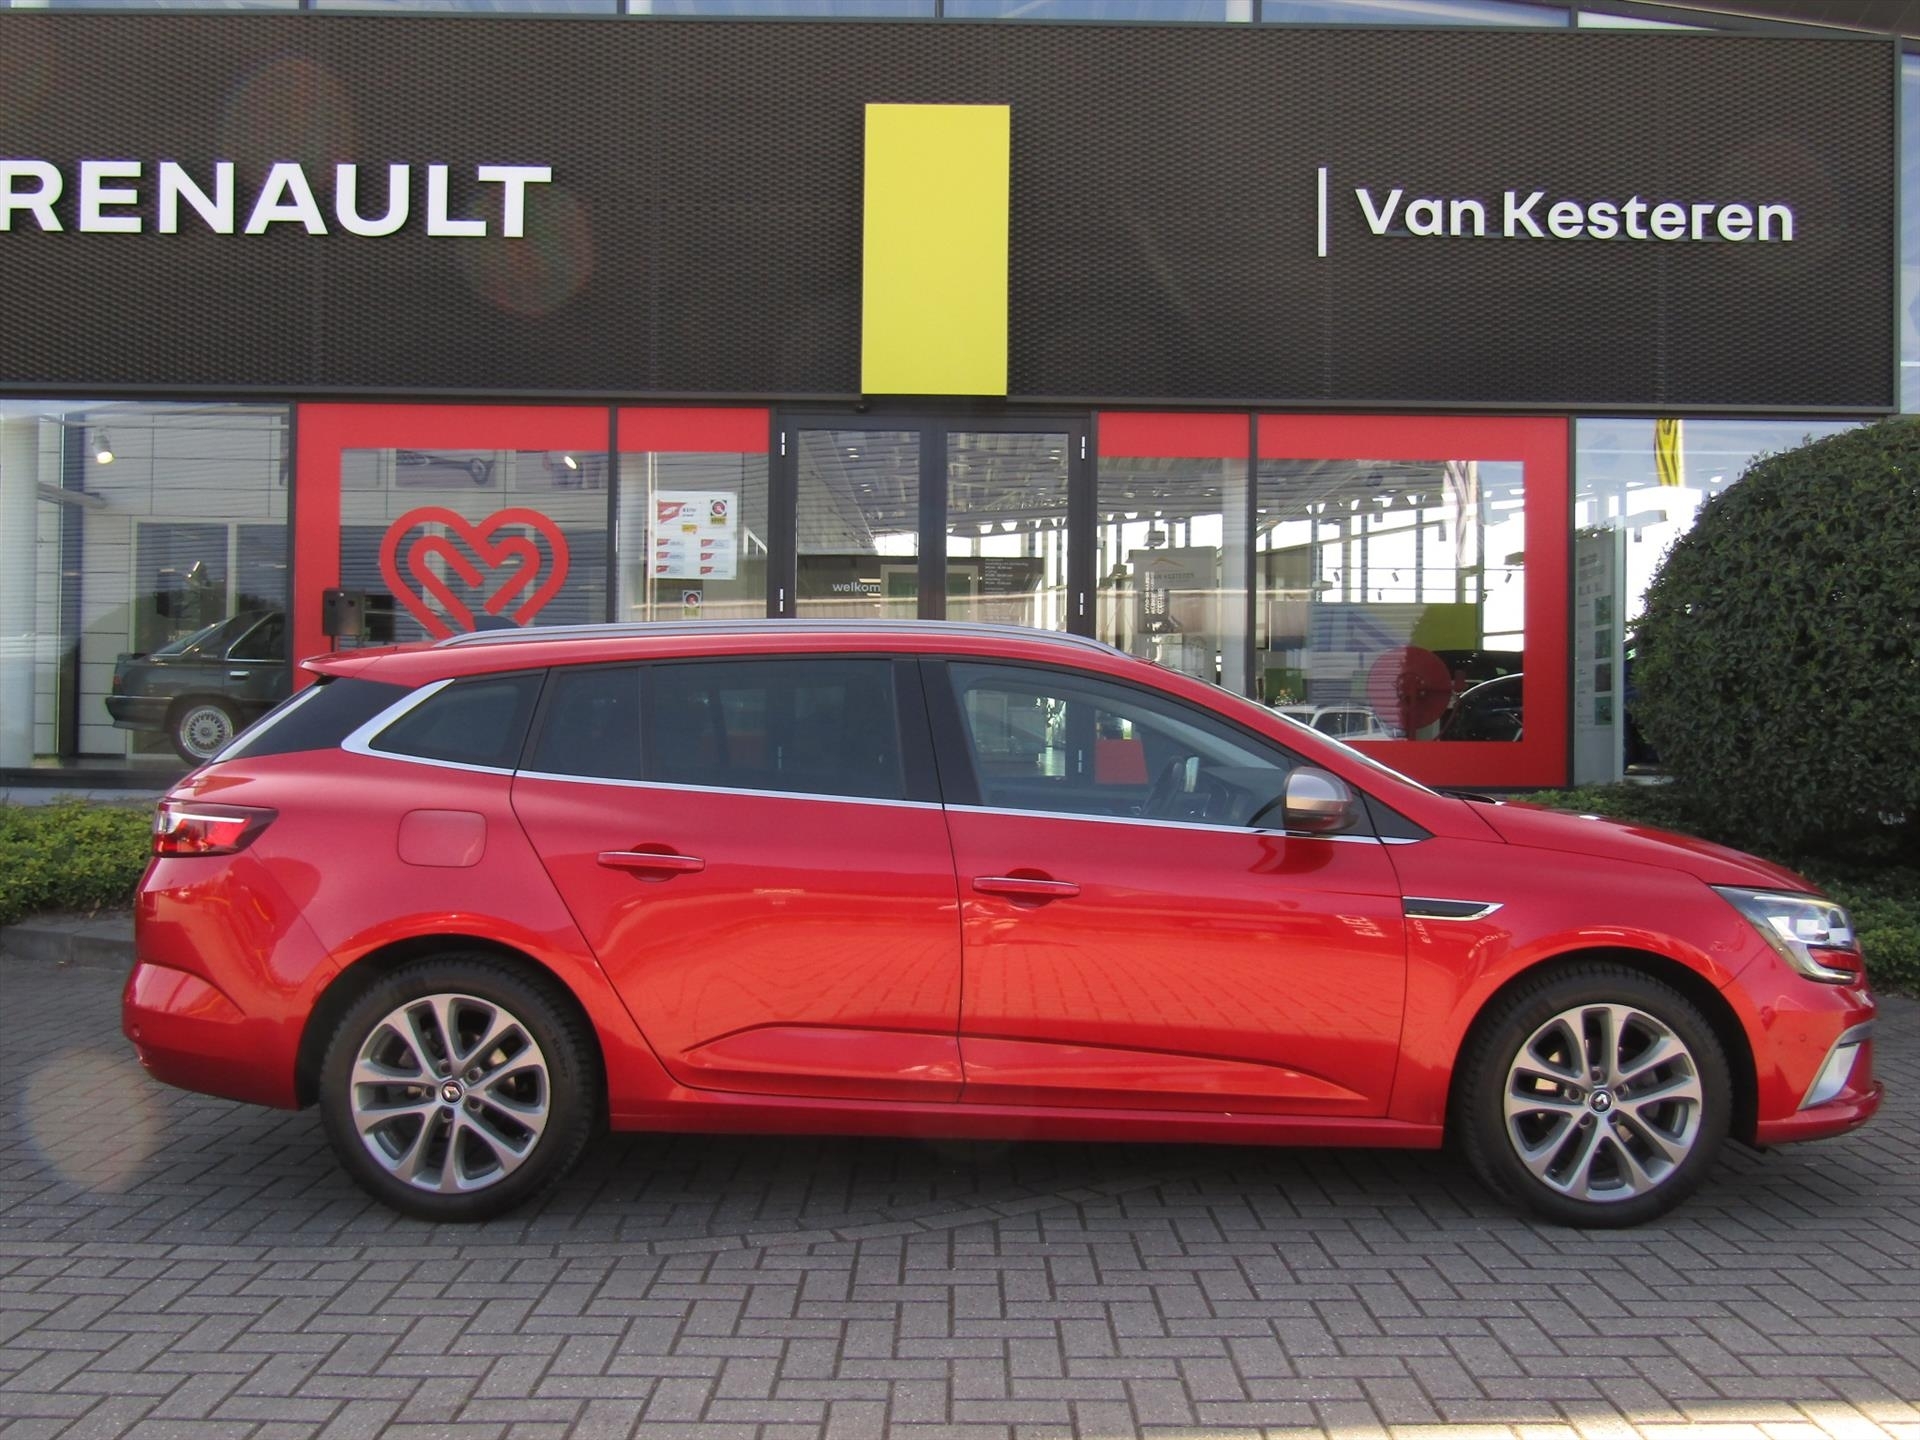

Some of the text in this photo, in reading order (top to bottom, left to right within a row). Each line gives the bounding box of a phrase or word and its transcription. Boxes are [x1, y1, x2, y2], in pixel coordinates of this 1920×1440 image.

[0, 160, 551, 237] RENAULT
[1356, 189, 1792, 240] Van Kesteren
[832, 582, 880, 592] welkom
